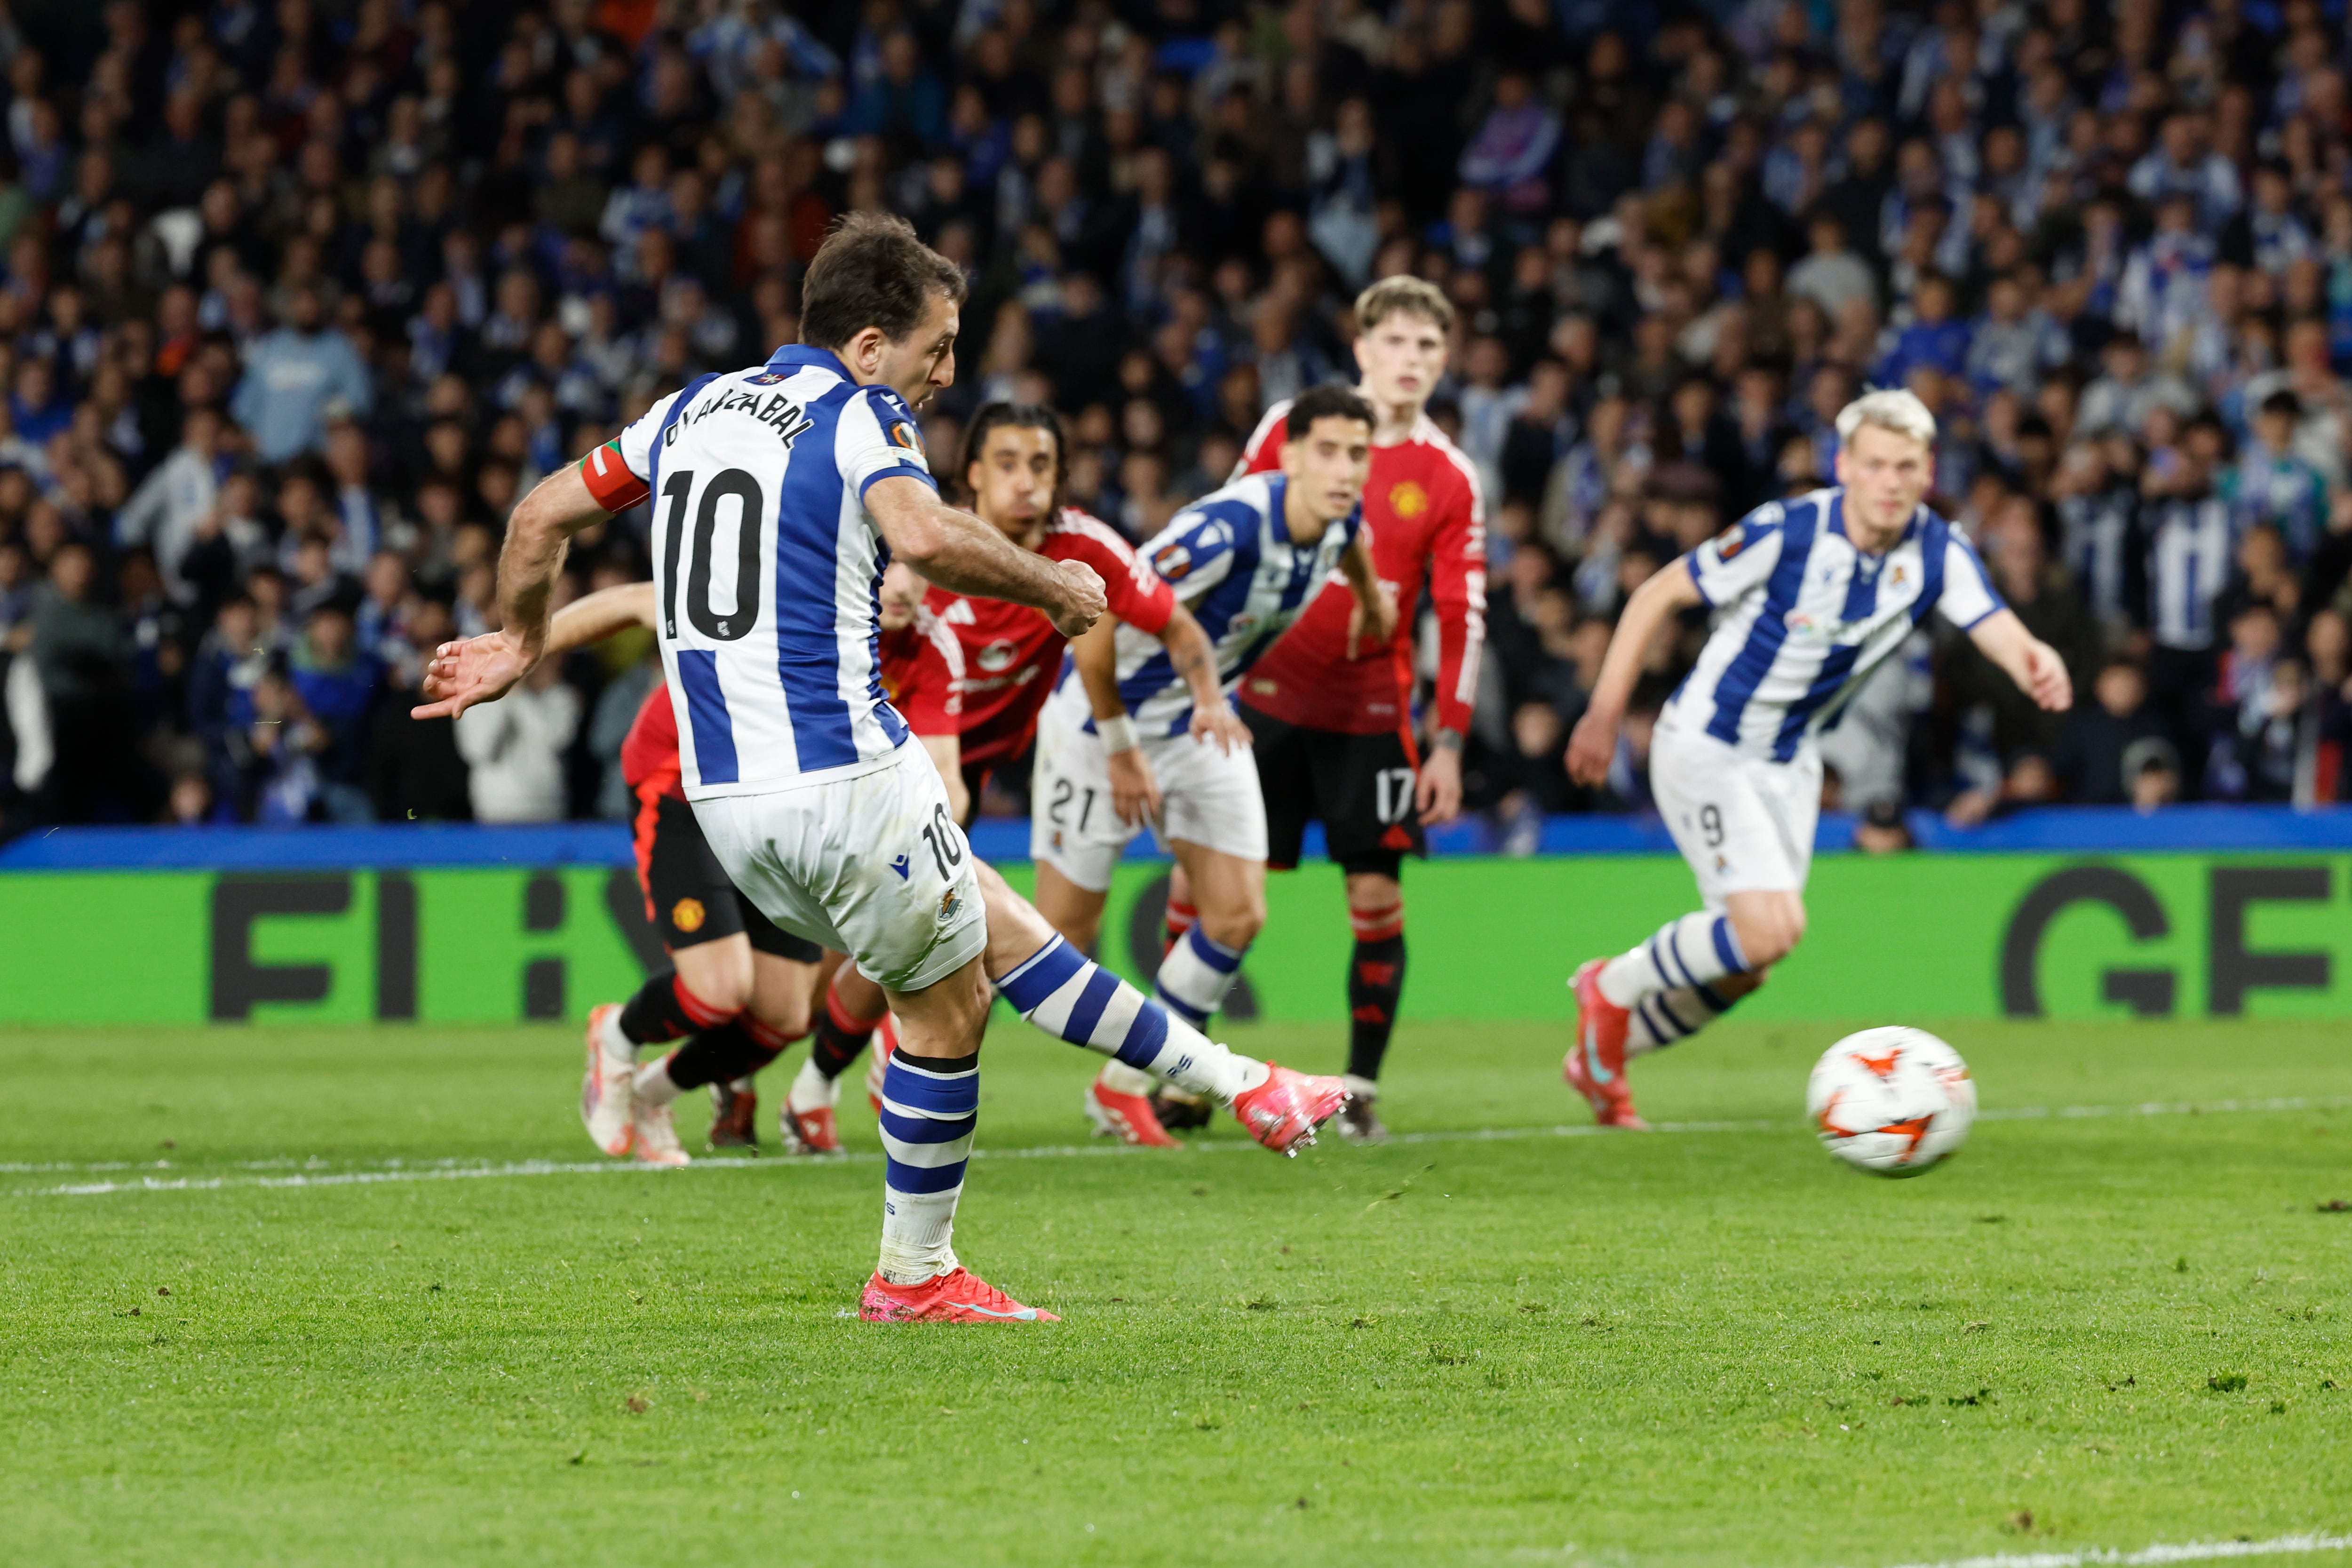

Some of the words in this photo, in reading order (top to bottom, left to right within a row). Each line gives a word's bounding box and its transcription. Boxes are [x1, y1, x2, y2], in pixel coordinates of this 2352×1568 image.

[661, 468, 763, 641] 10
[1049, 779, 1095, 833] 21
[1376, 767, 1417, 824] 17
[922, 802, 961, 882] 10
[1699, 804, 1725, 847] 9
